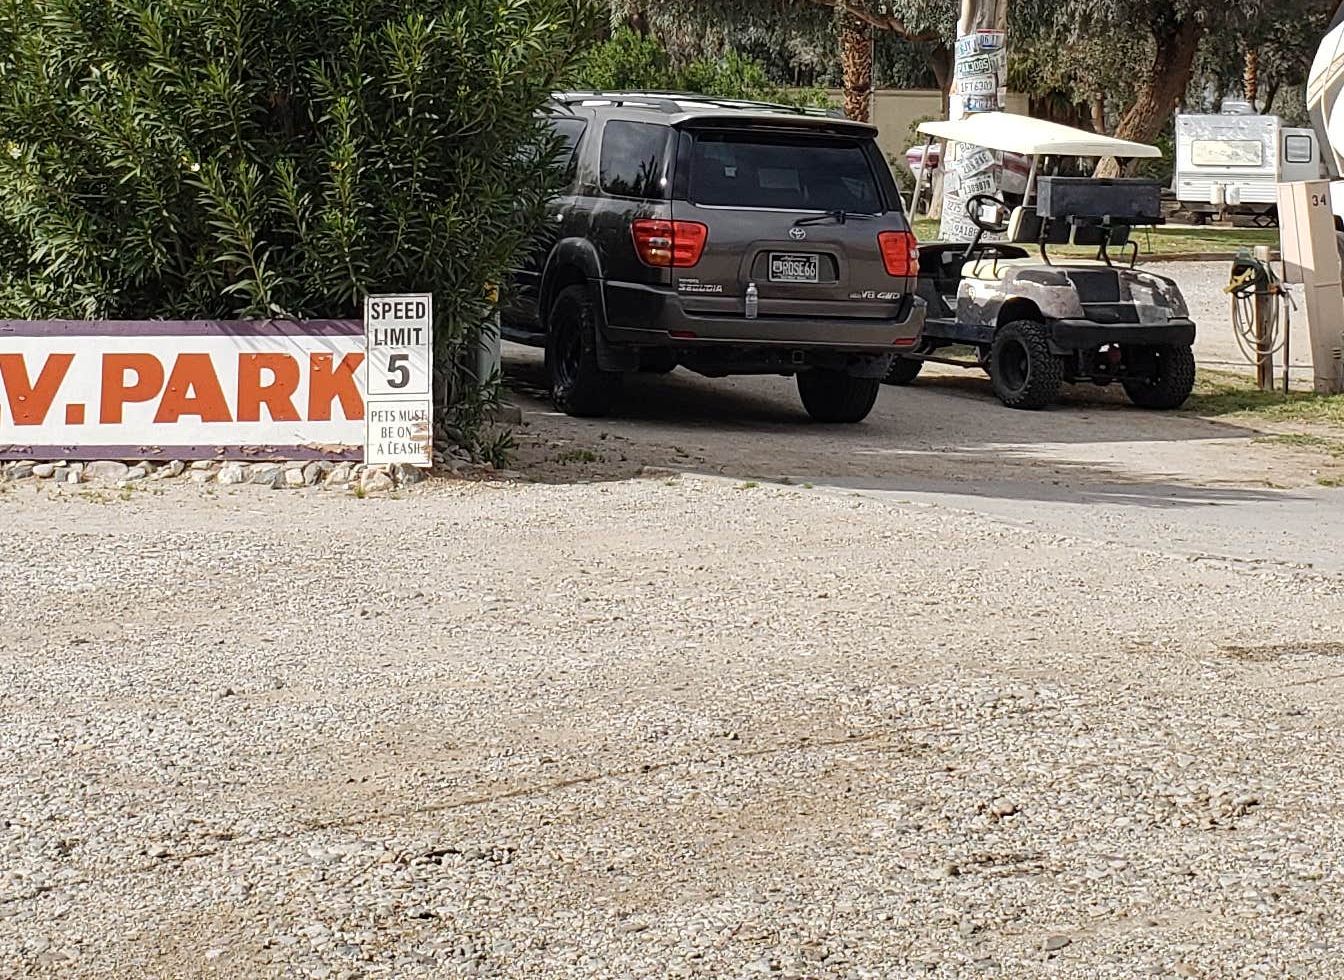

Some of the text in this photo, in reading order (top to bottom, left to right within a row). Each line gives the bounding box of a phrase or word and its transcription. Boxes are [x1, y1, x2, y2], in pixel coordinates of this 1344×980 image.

[1312, 194, 1327, 207] 34
[782, 261, 816, 276] ROSE66
[371, 302, 426, 320] SPEED
[374, 327, 423, 346] LIMIT
[386, 353, 410, 389] 5
[371, 409, 426, 423] PETS MUST
[381, 427, 412, 438] BE ON
[377, 442, 420, 455] A LEASH
